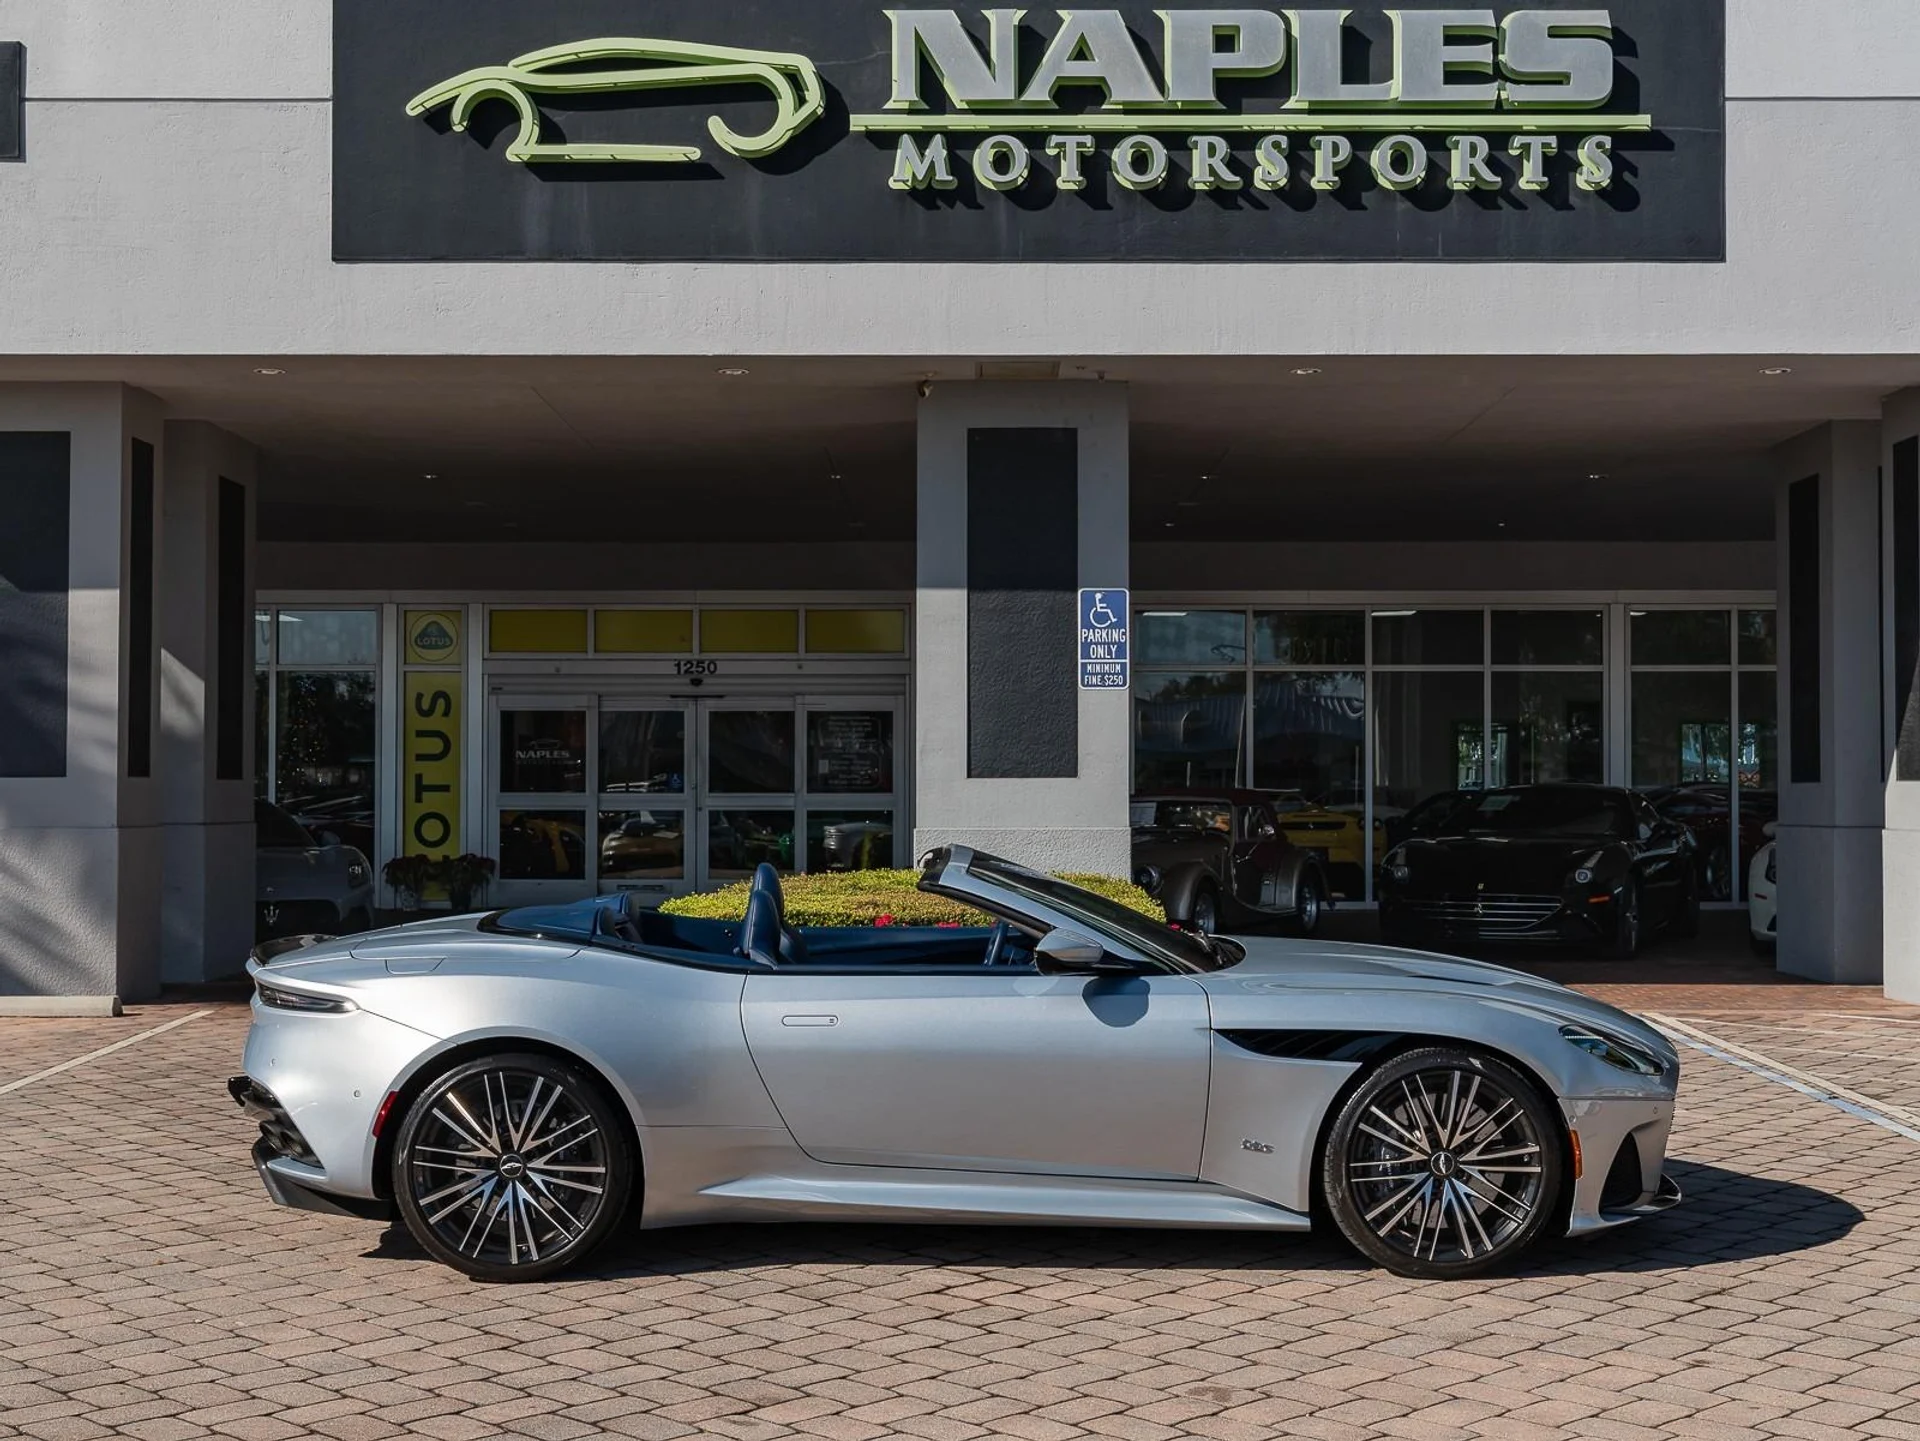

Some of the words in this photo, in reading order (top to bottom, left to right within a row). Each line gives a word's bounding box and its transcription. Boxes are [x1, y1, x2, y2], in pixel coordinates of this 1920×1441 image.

[882, 8, 1615, 110] NAPLES
[888, 133, 1614, 192] MOTORSPORTS
[417, 636, 452, 646] LOTUS
[1082, 628, 1126, 643] PARKING
[1090, 645, 1117, 659] ONLY
[673, 660, 717, 675] 1250
[1086, 663, 1121, 673] MINIMUM
[1084, 675, 1102, 685] FINE
[1103, 674, 1123, 686] $250
[514, 749, 570, 759] NAPLES
[413, 690, 452, 863] OTUS
